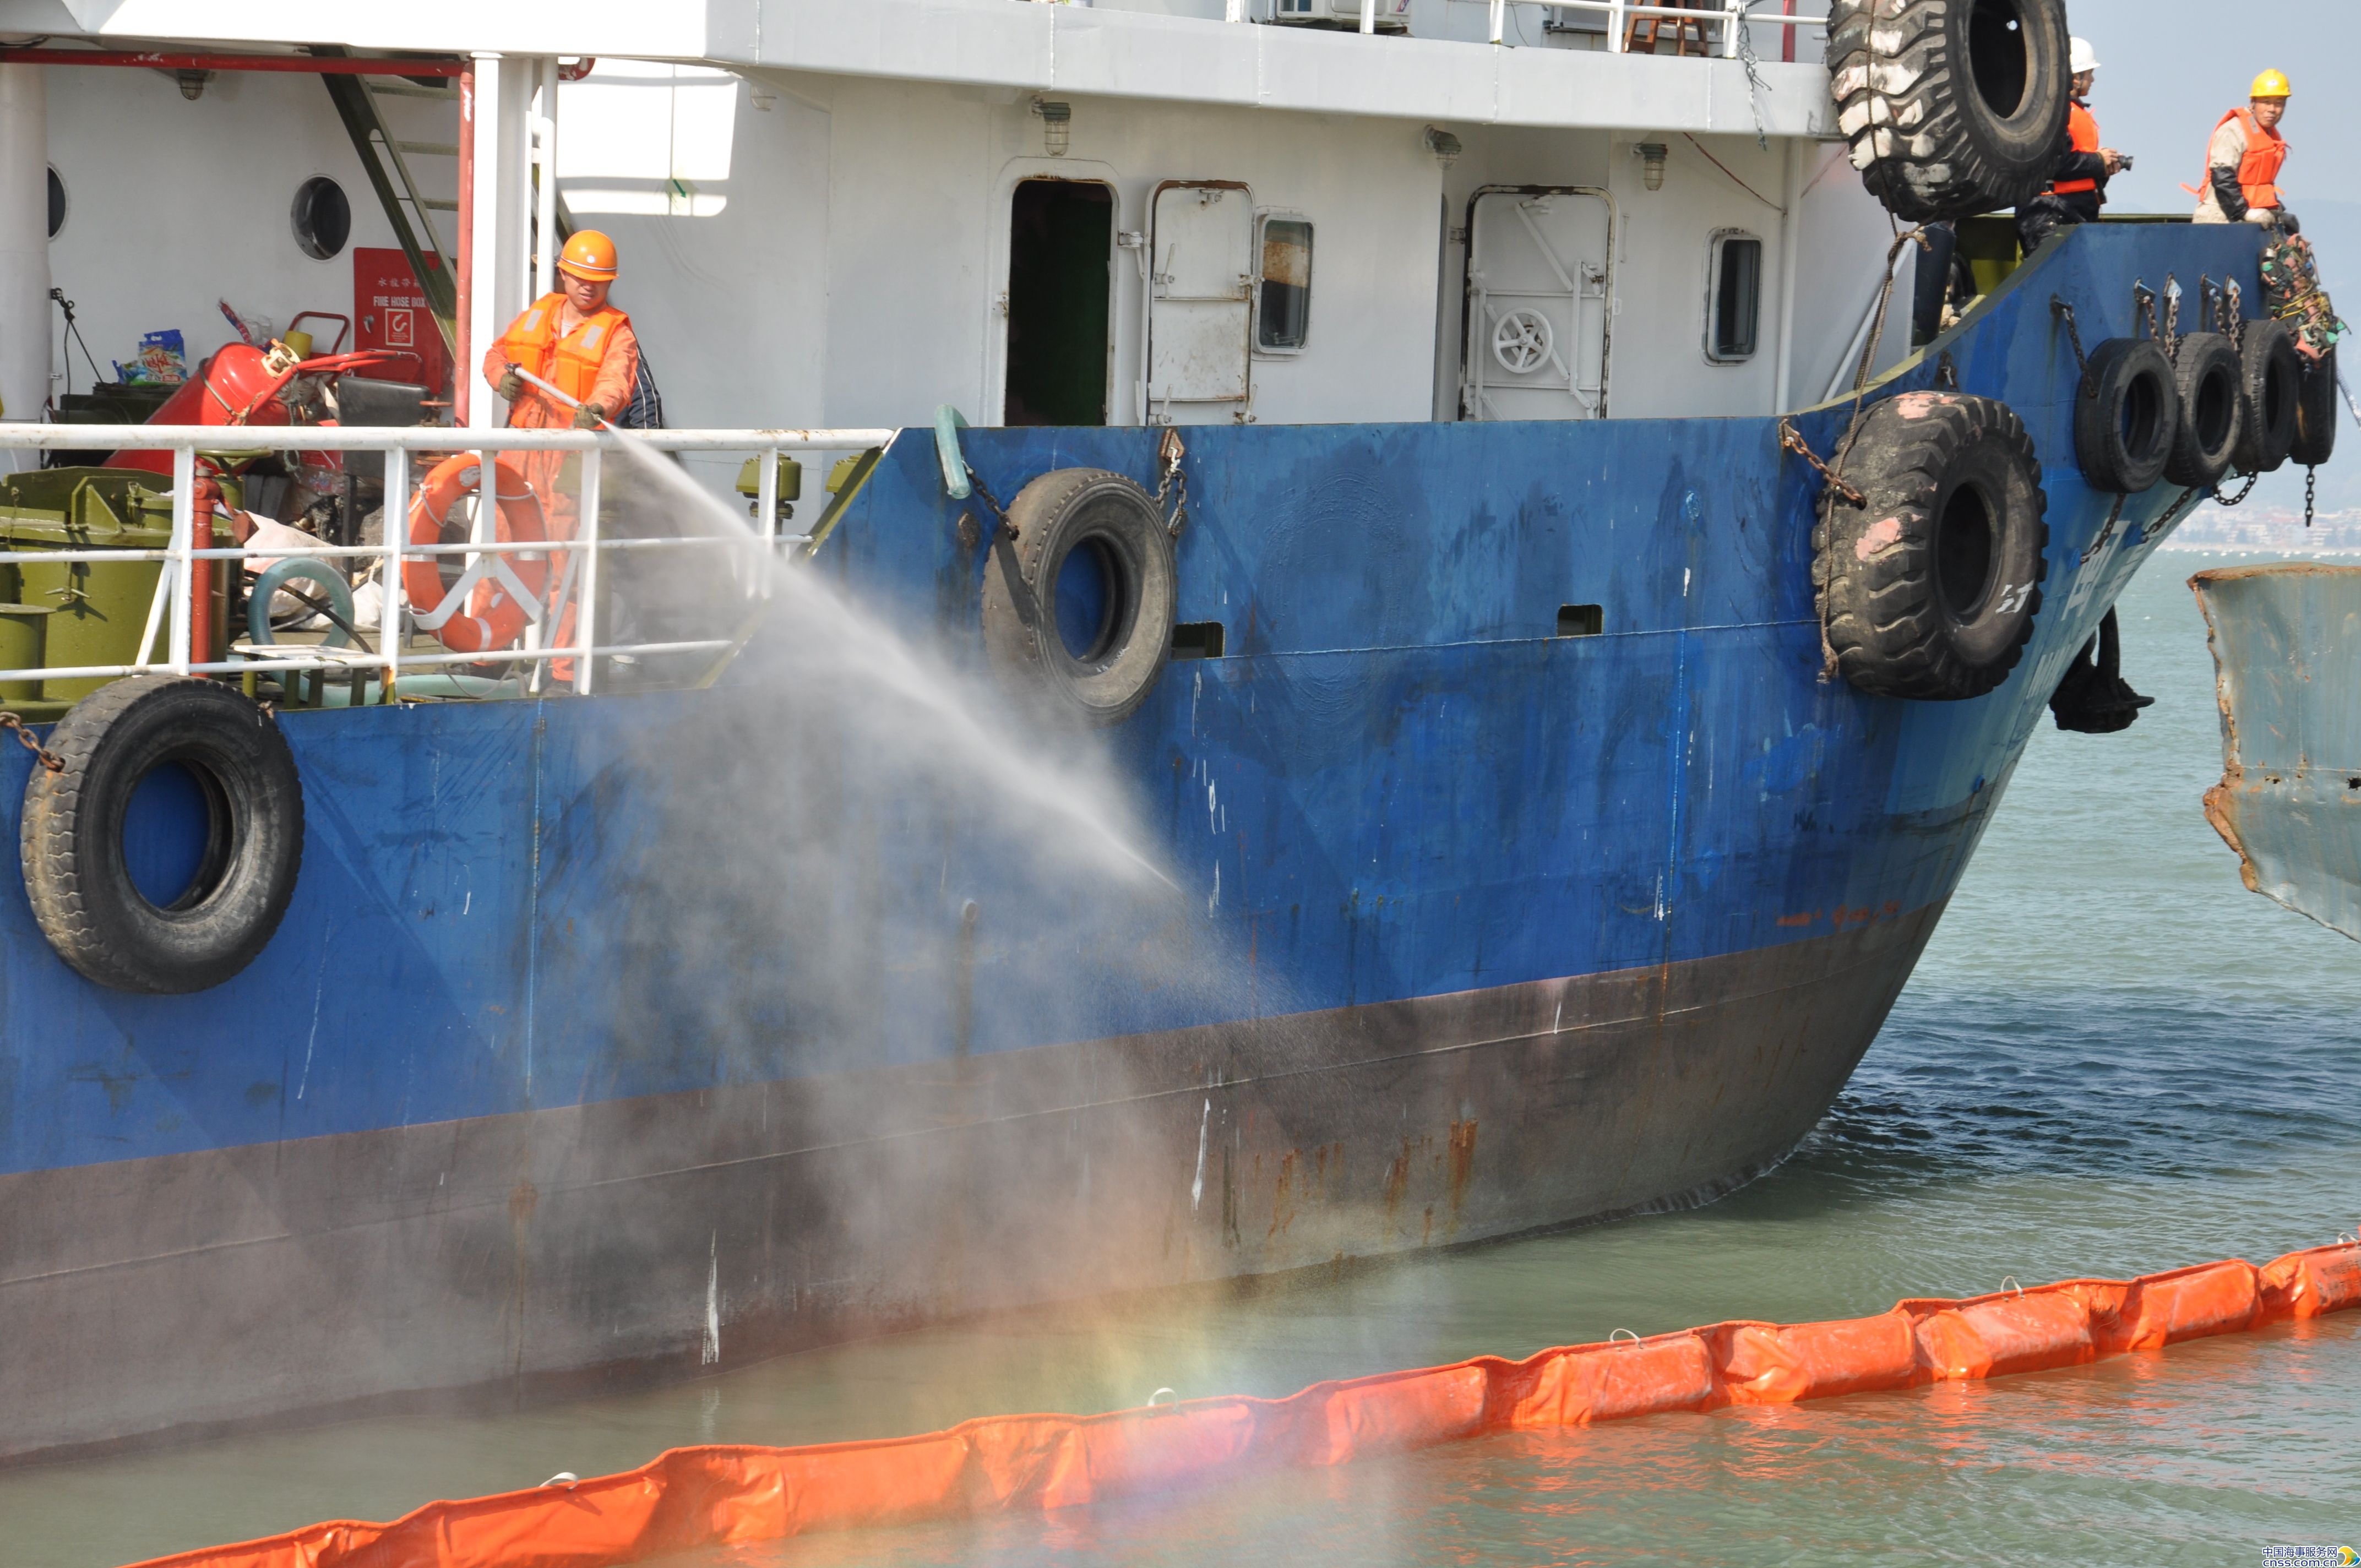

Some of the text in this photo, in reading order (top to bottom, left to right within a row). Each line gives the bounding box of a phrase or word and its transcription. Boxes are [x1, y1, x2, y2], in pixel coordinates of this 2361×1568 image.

[373, 296, 426, 308] FIRE HOSE BOX
